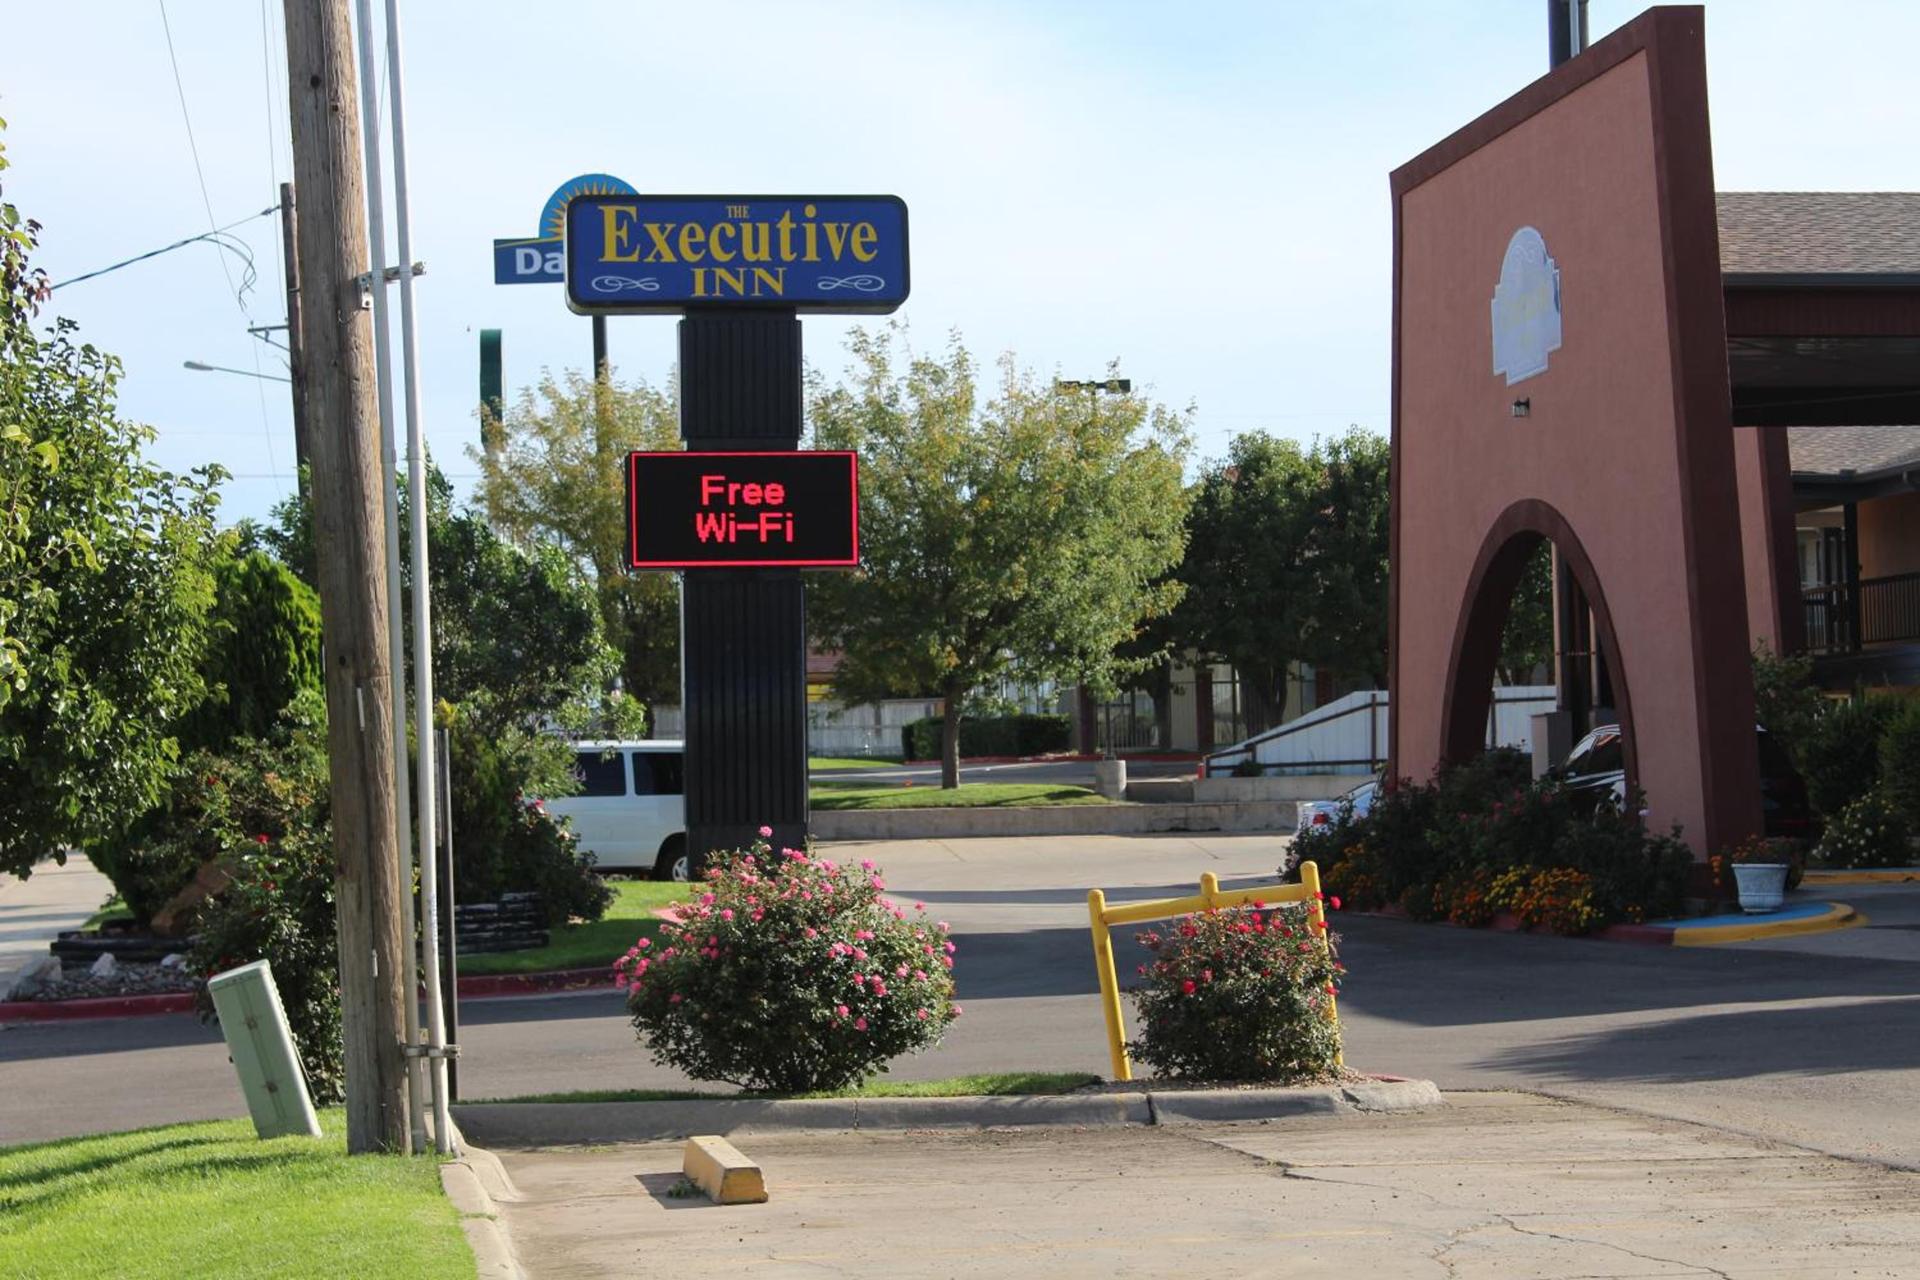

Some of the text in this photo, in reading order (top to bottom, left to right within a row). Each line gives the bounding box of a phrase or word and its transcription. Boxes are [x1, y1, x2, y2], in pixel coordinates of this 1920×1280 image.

[726, 205, 749, 219] THE
[598, 204, 878, 262] Executive
[691, 267, 787, 297] INN
[701, 475, 785, 505] Free
[696, 512, 793, 543] Wi-Fi
